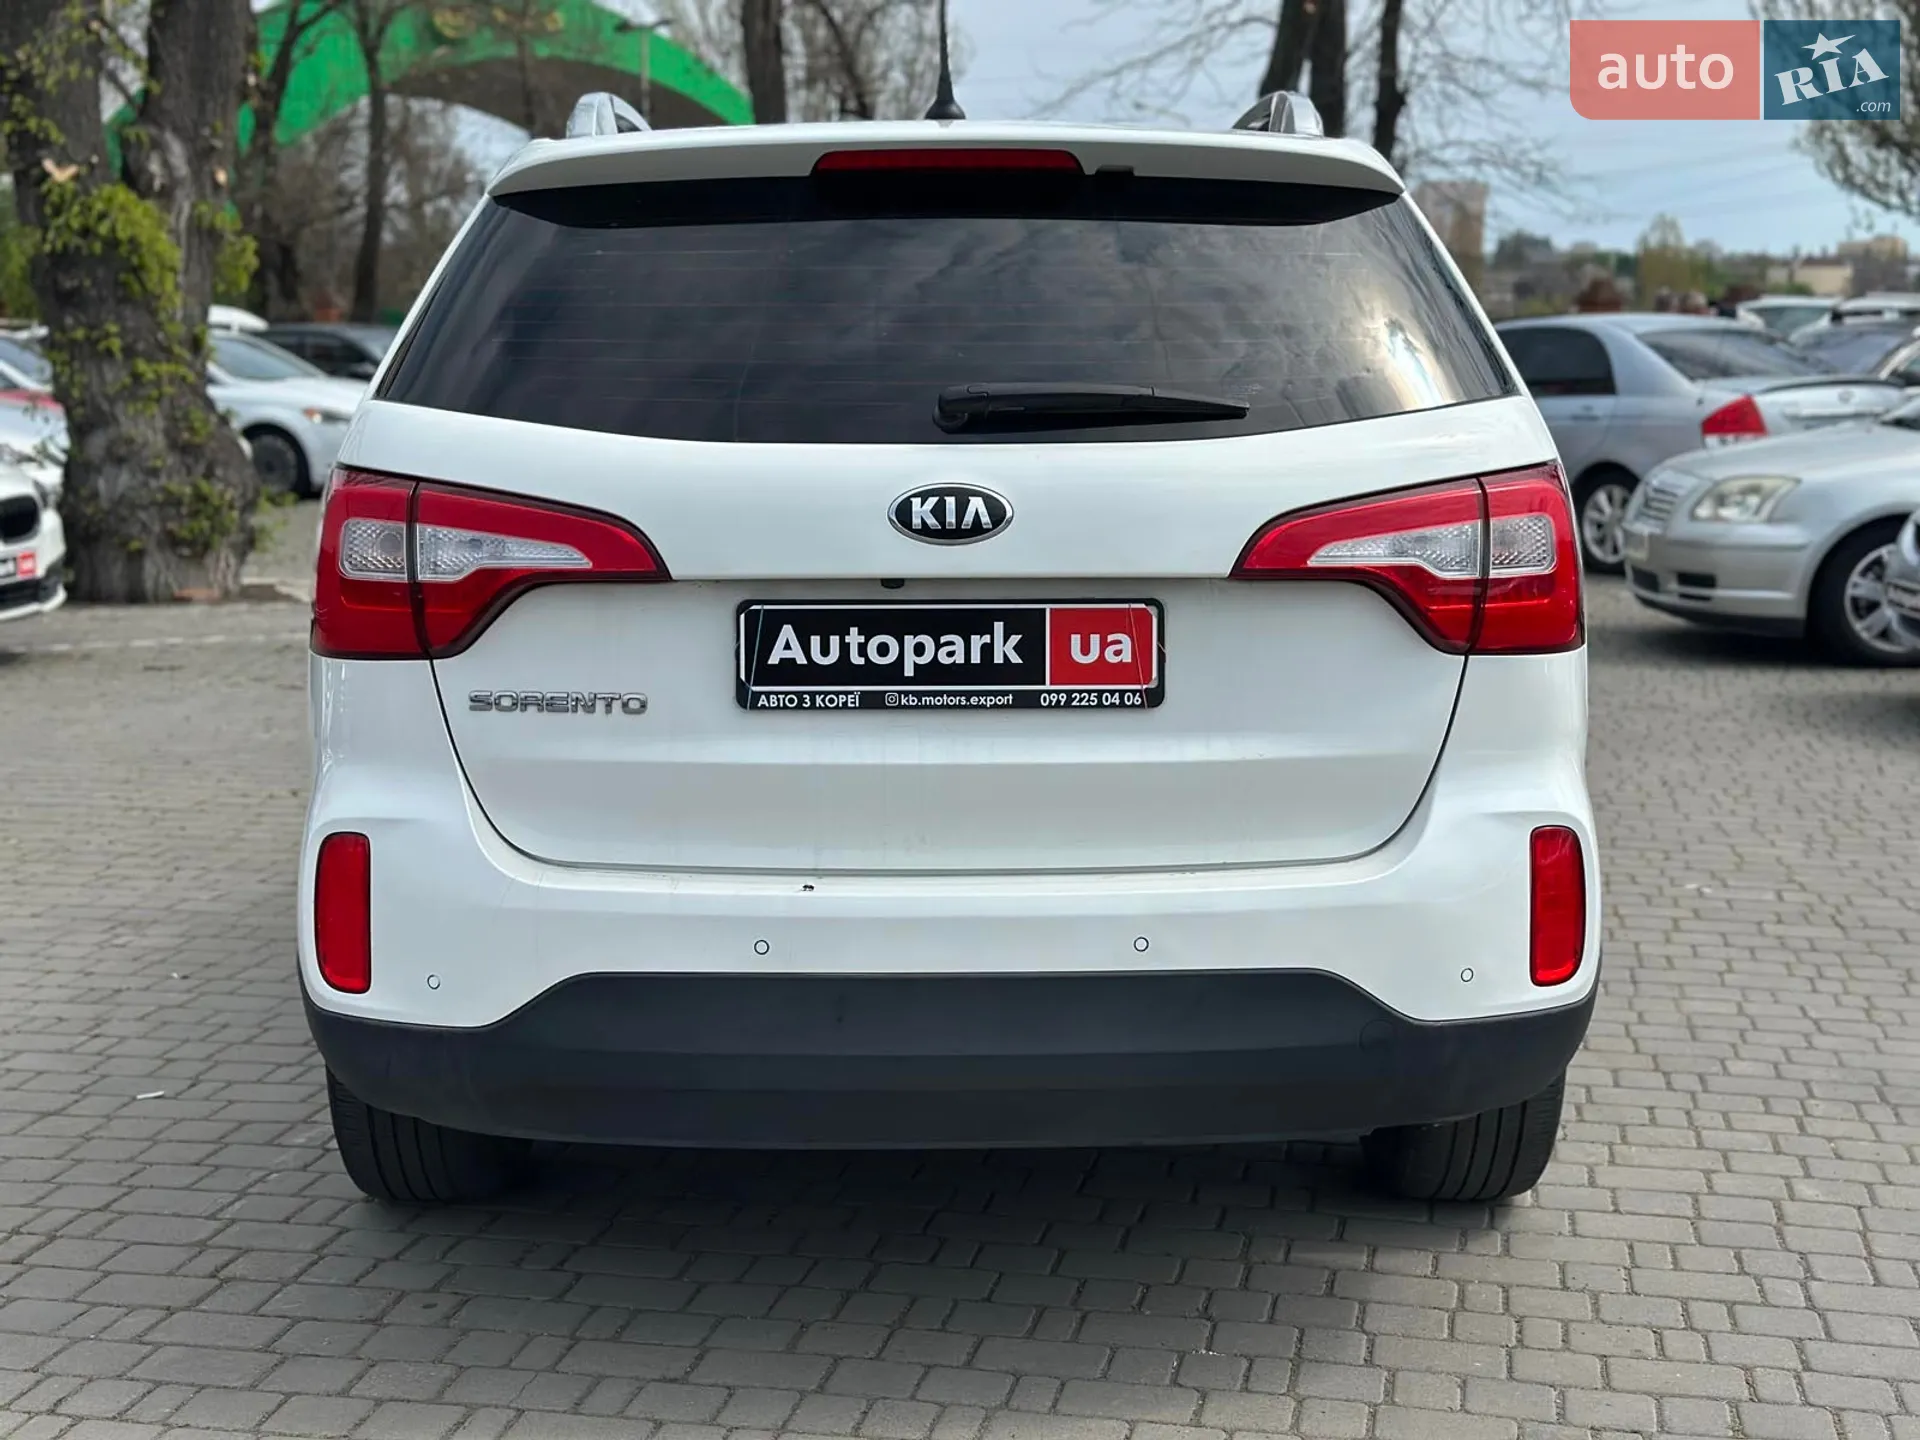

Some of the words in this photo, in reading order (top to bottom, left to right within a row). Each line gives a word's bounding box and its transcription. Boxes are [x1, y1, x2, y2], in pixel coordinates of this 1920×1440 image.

[909, 496, 993, 529] KIA
[767, 621, 1024, 677] Autopark
[1070, 632, 1132, 664] ua
[468, 690, 649, 715] SORENTO
[757, 694, 798, 708] АВТО
[815, 691, 860, 708] КОРЕЇ
[901, 693, 1013, 708] kb.motors.export
[1040, 693, 1067, 707] 099
[1071, 692, 1098, 706] 225
[1102, 692, 1120, 706] 04
[1124, 692, 1142, 706] 06
